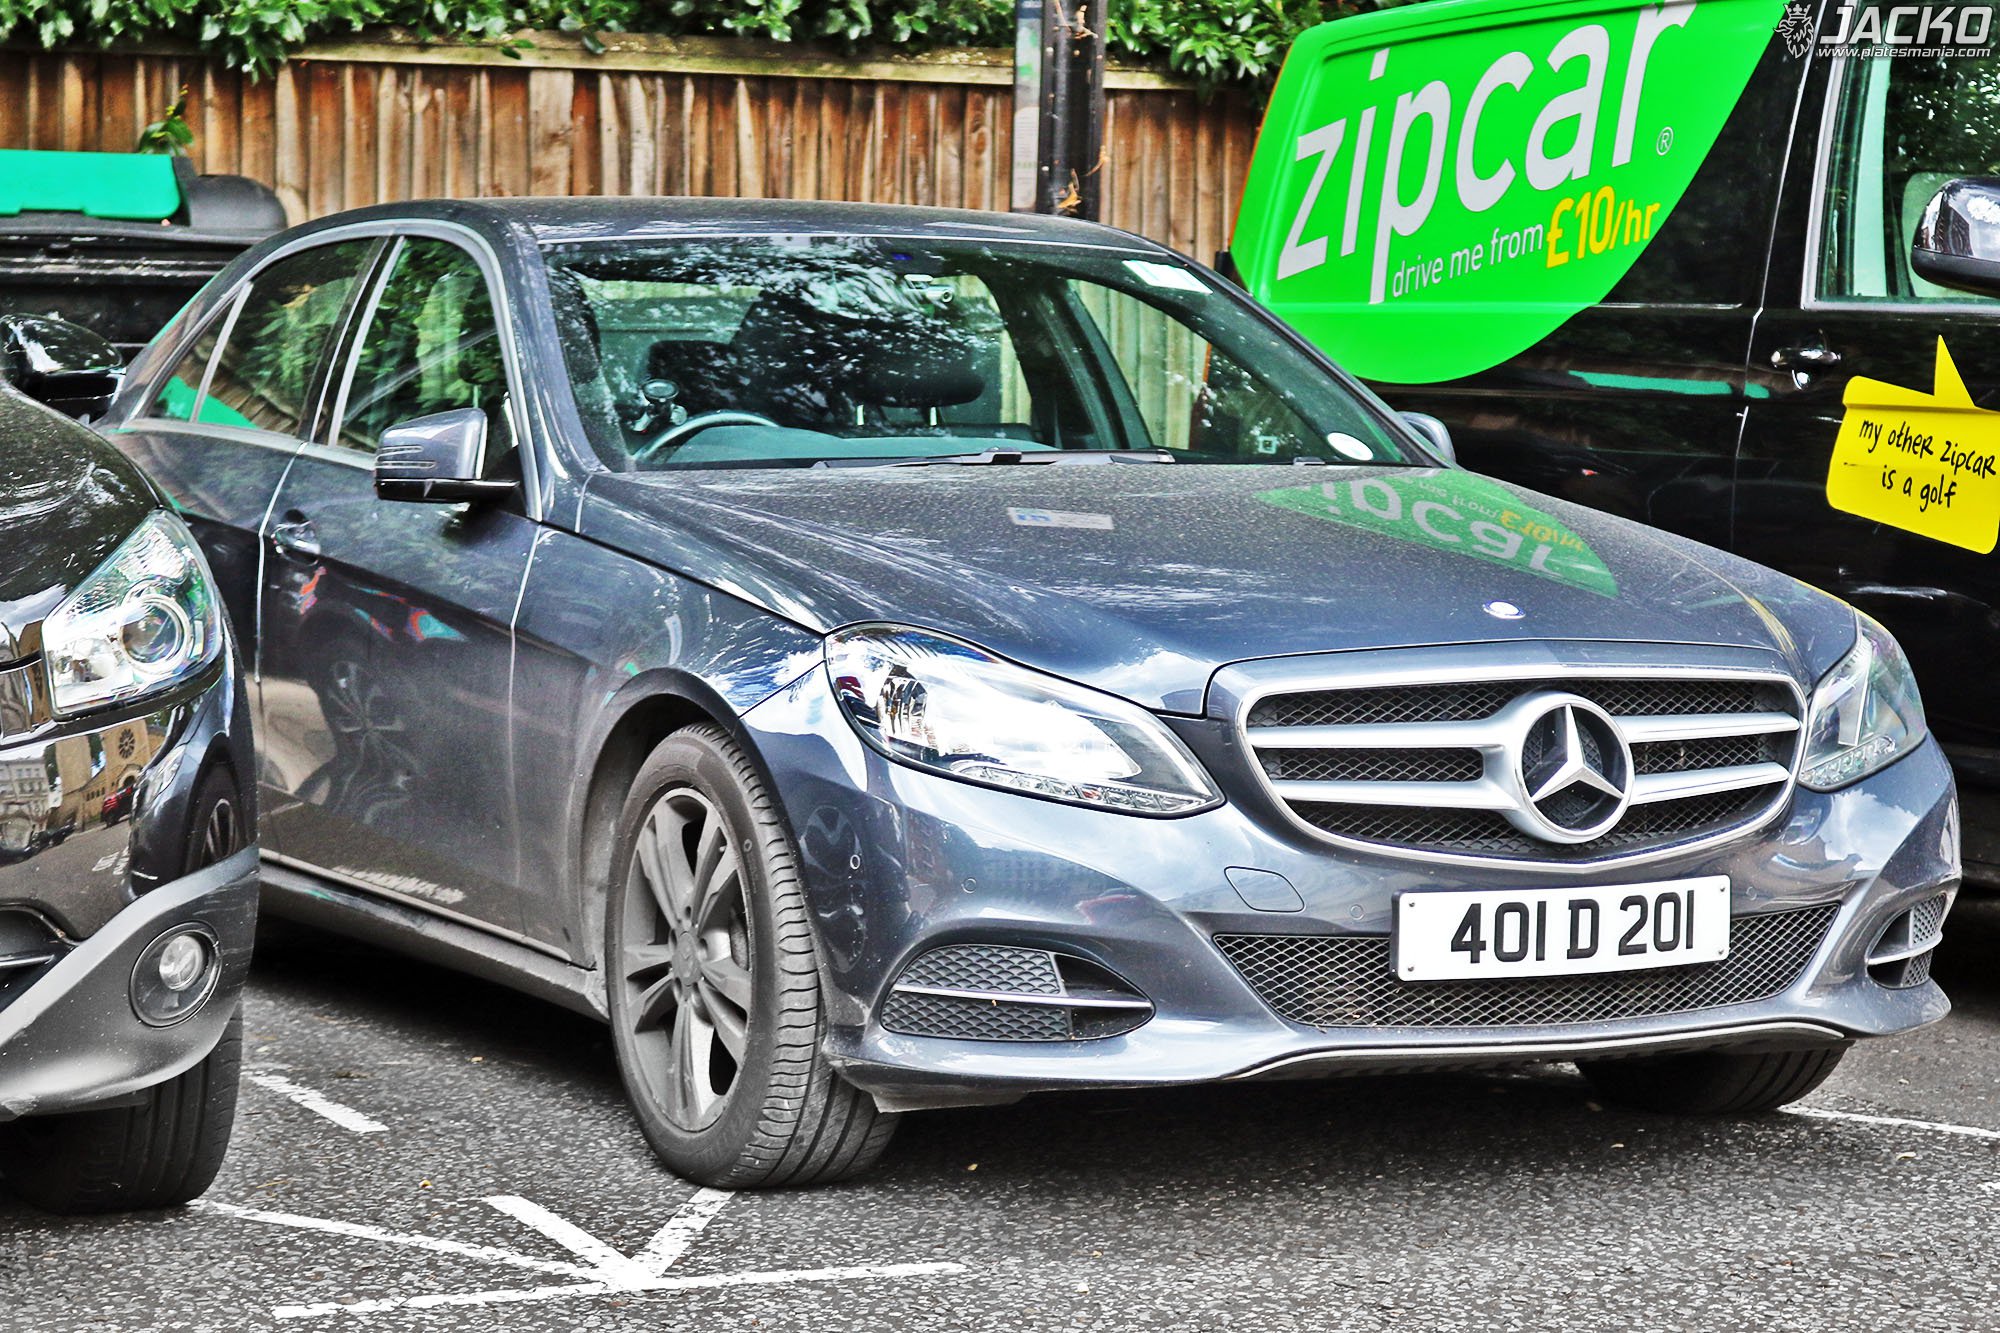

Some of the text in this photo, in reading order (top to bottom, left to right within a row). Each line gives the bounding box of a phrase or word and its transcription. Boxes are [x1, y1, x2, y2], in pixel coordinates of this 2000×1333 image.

[1276, 2, 1697, 304] zipcar
[1392, 185, 1661, 298] drive me from £10/hr
[1859, 420, 1883, 453] my
[1882, 465, 1957, 512] is a golf
[1450, 889, 1695, 964] 401 D 201
